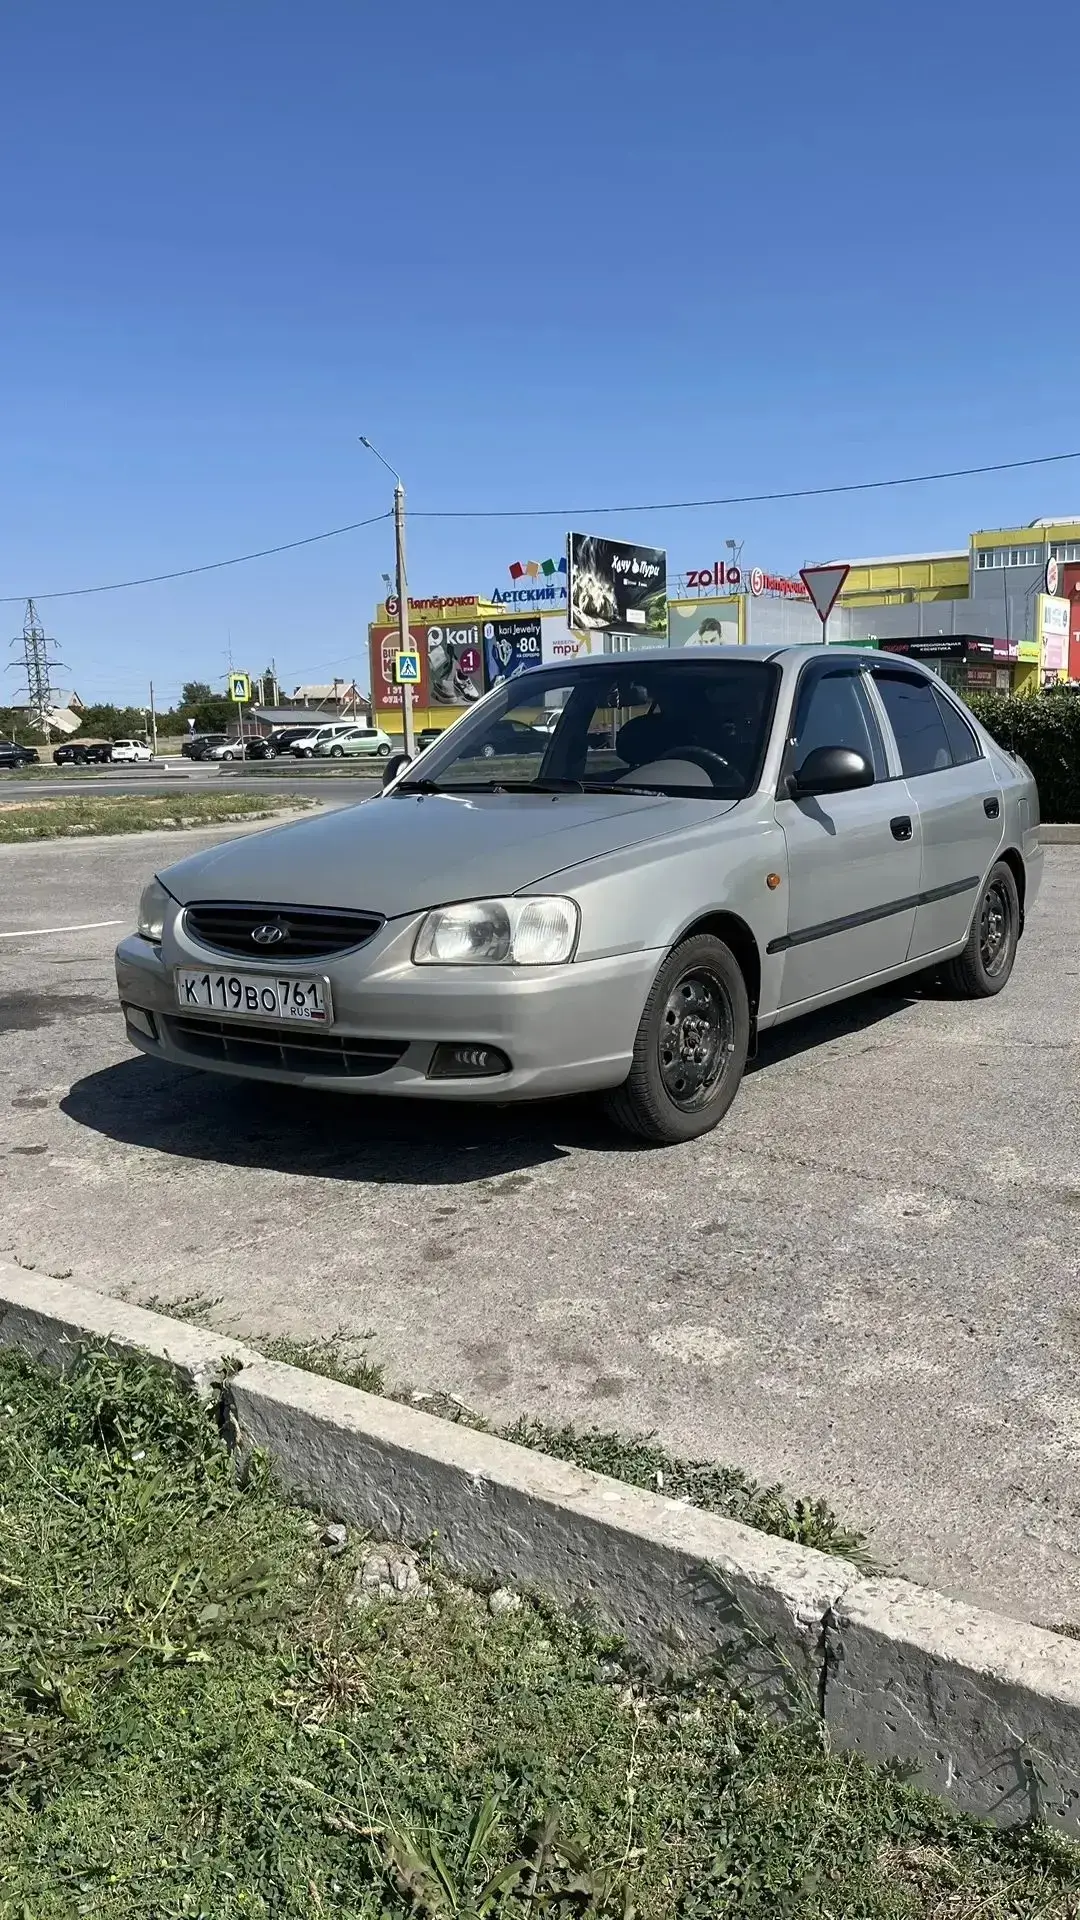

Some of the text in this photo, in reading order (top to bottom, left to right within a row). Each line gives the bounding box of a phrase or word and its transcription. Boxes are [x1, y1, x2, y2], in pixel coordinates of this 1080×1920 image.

[686, 561, 741, 588] zolla
[491, 584, 555, 604] Детский
[446, 626, 478, 644] kari
[499, 624, 541, 636] kari Jewelry
[290, 1007, 311, 1017] RUS
